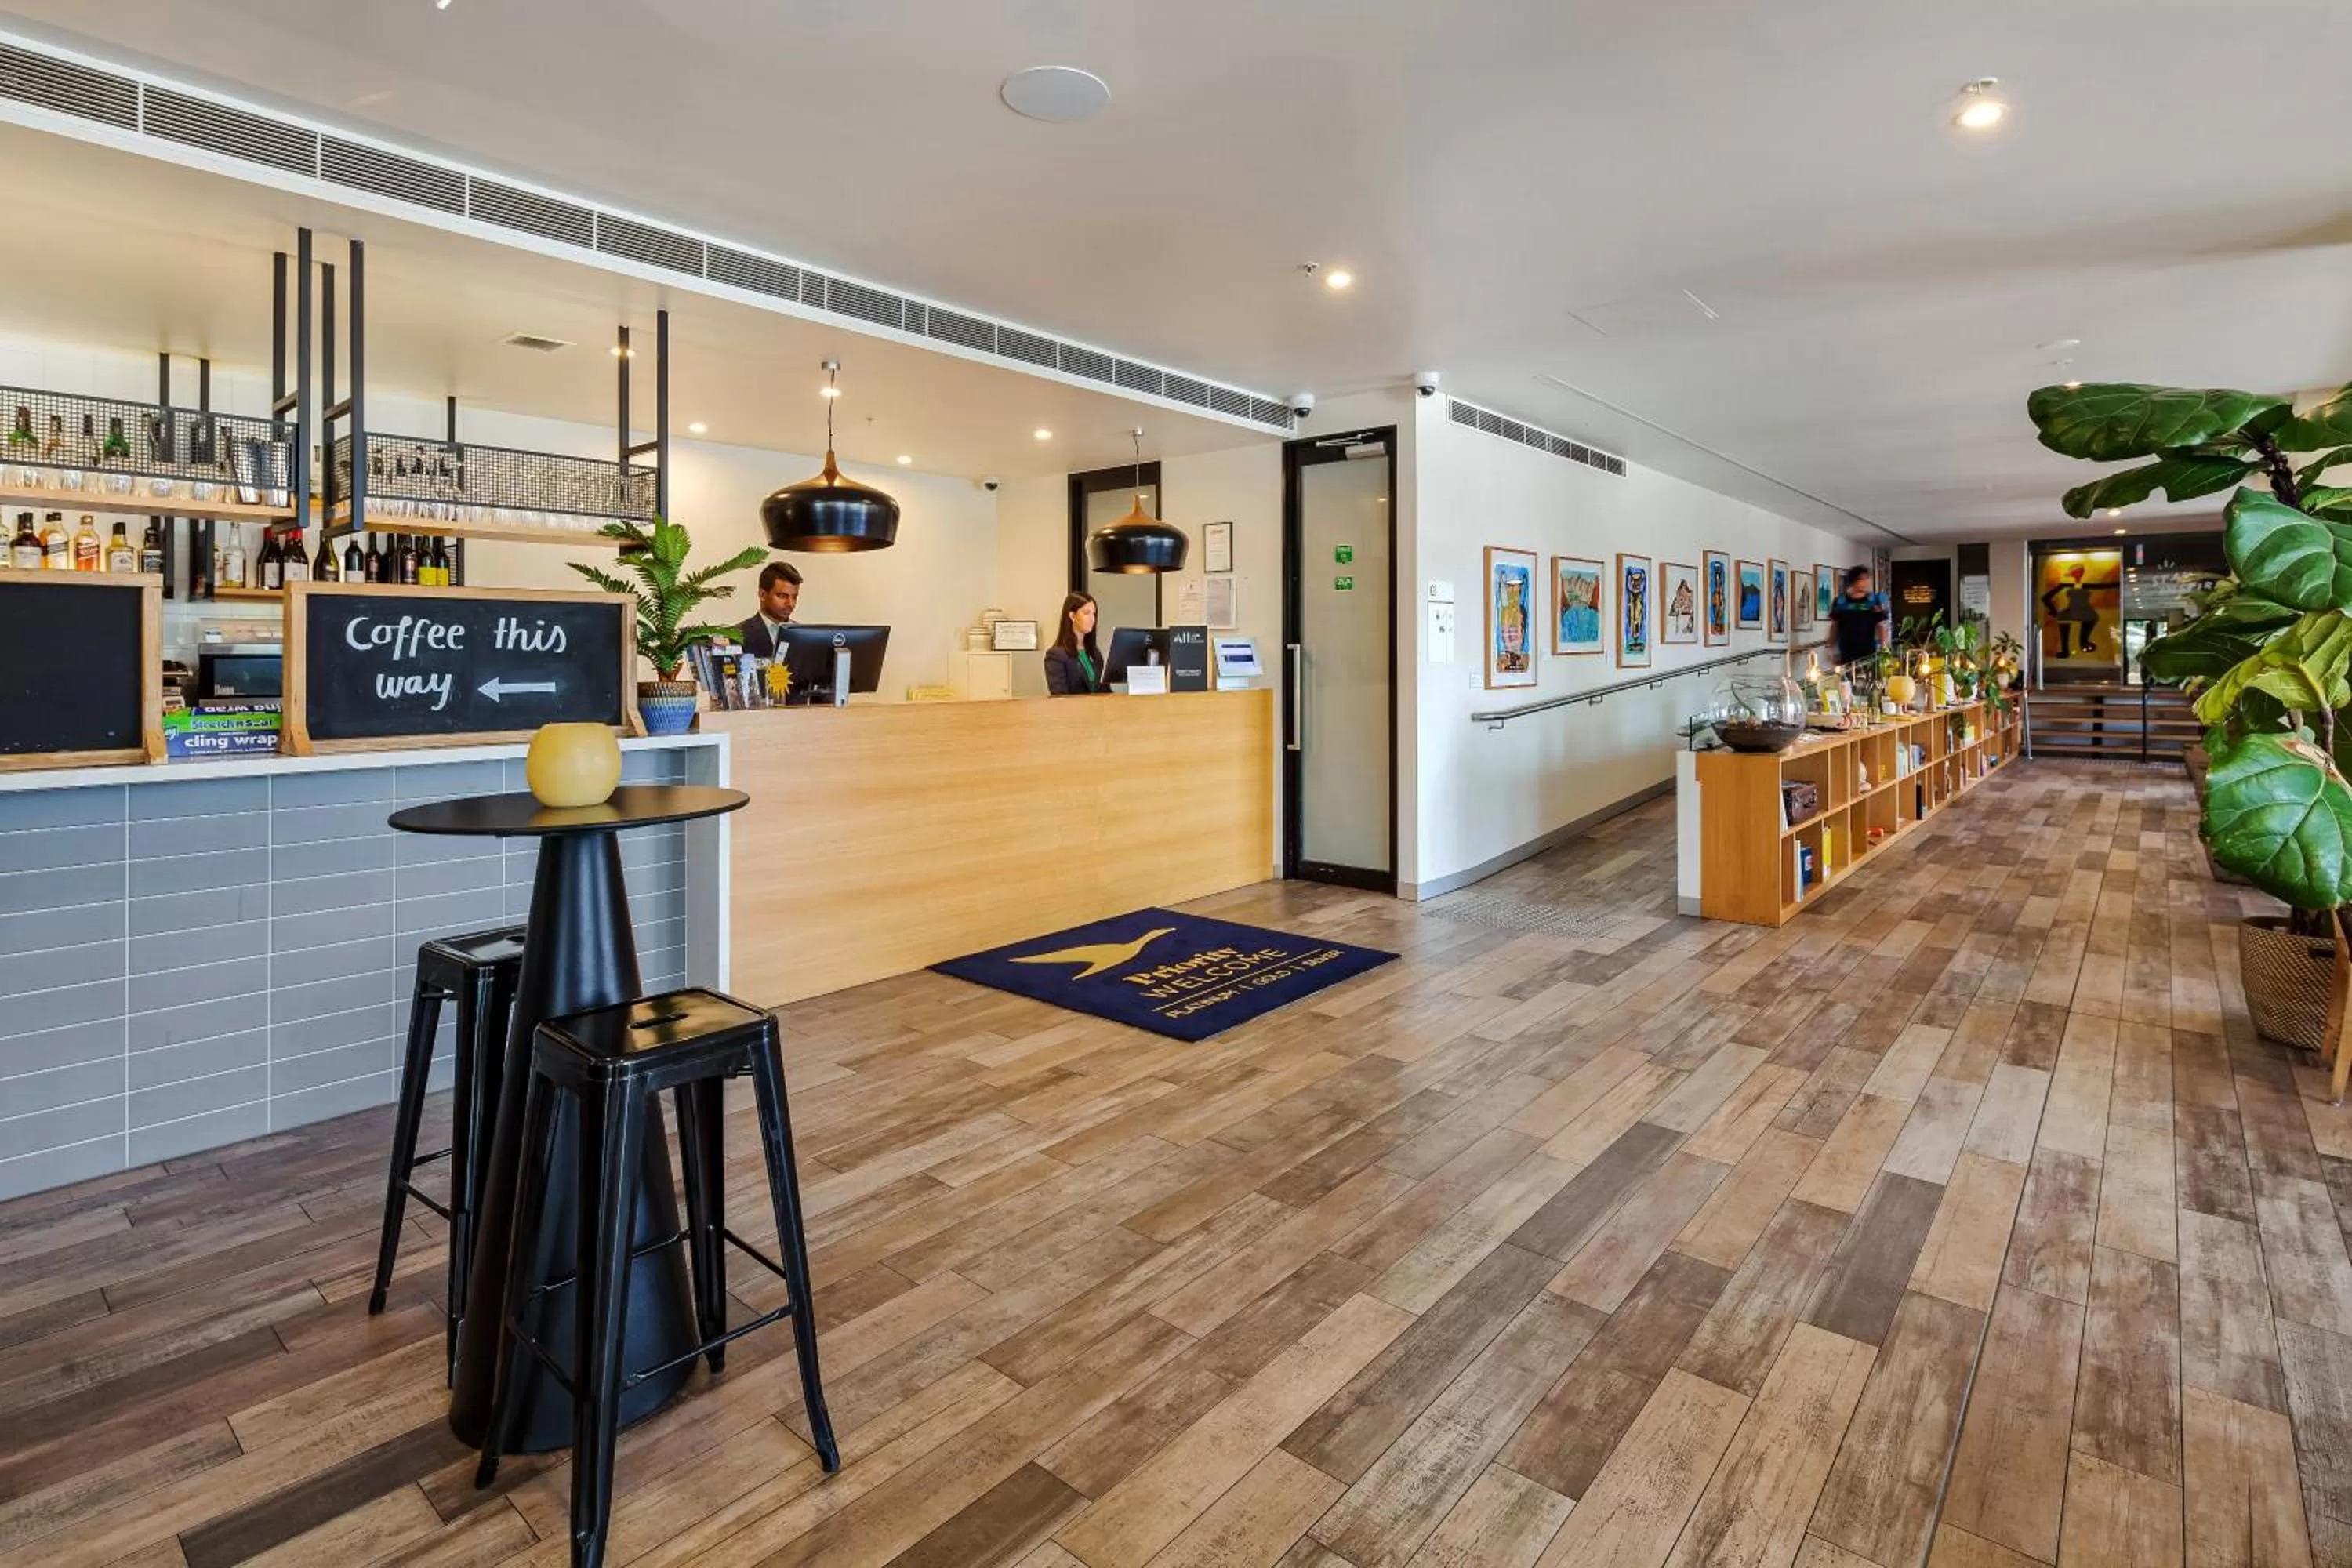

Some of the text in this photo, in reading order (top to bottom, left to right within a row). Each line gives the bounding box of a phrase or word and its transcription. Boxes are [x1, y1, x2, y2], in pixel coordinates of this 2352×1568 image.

[346, 615, 567, 661] Coffee this
[376, 672, 452, 711] way
[184, 735, 278, 749] cling wrap
[1122, 946, 1240, 985] Priority
[1138, 948, 1288, 998] WELCOME
